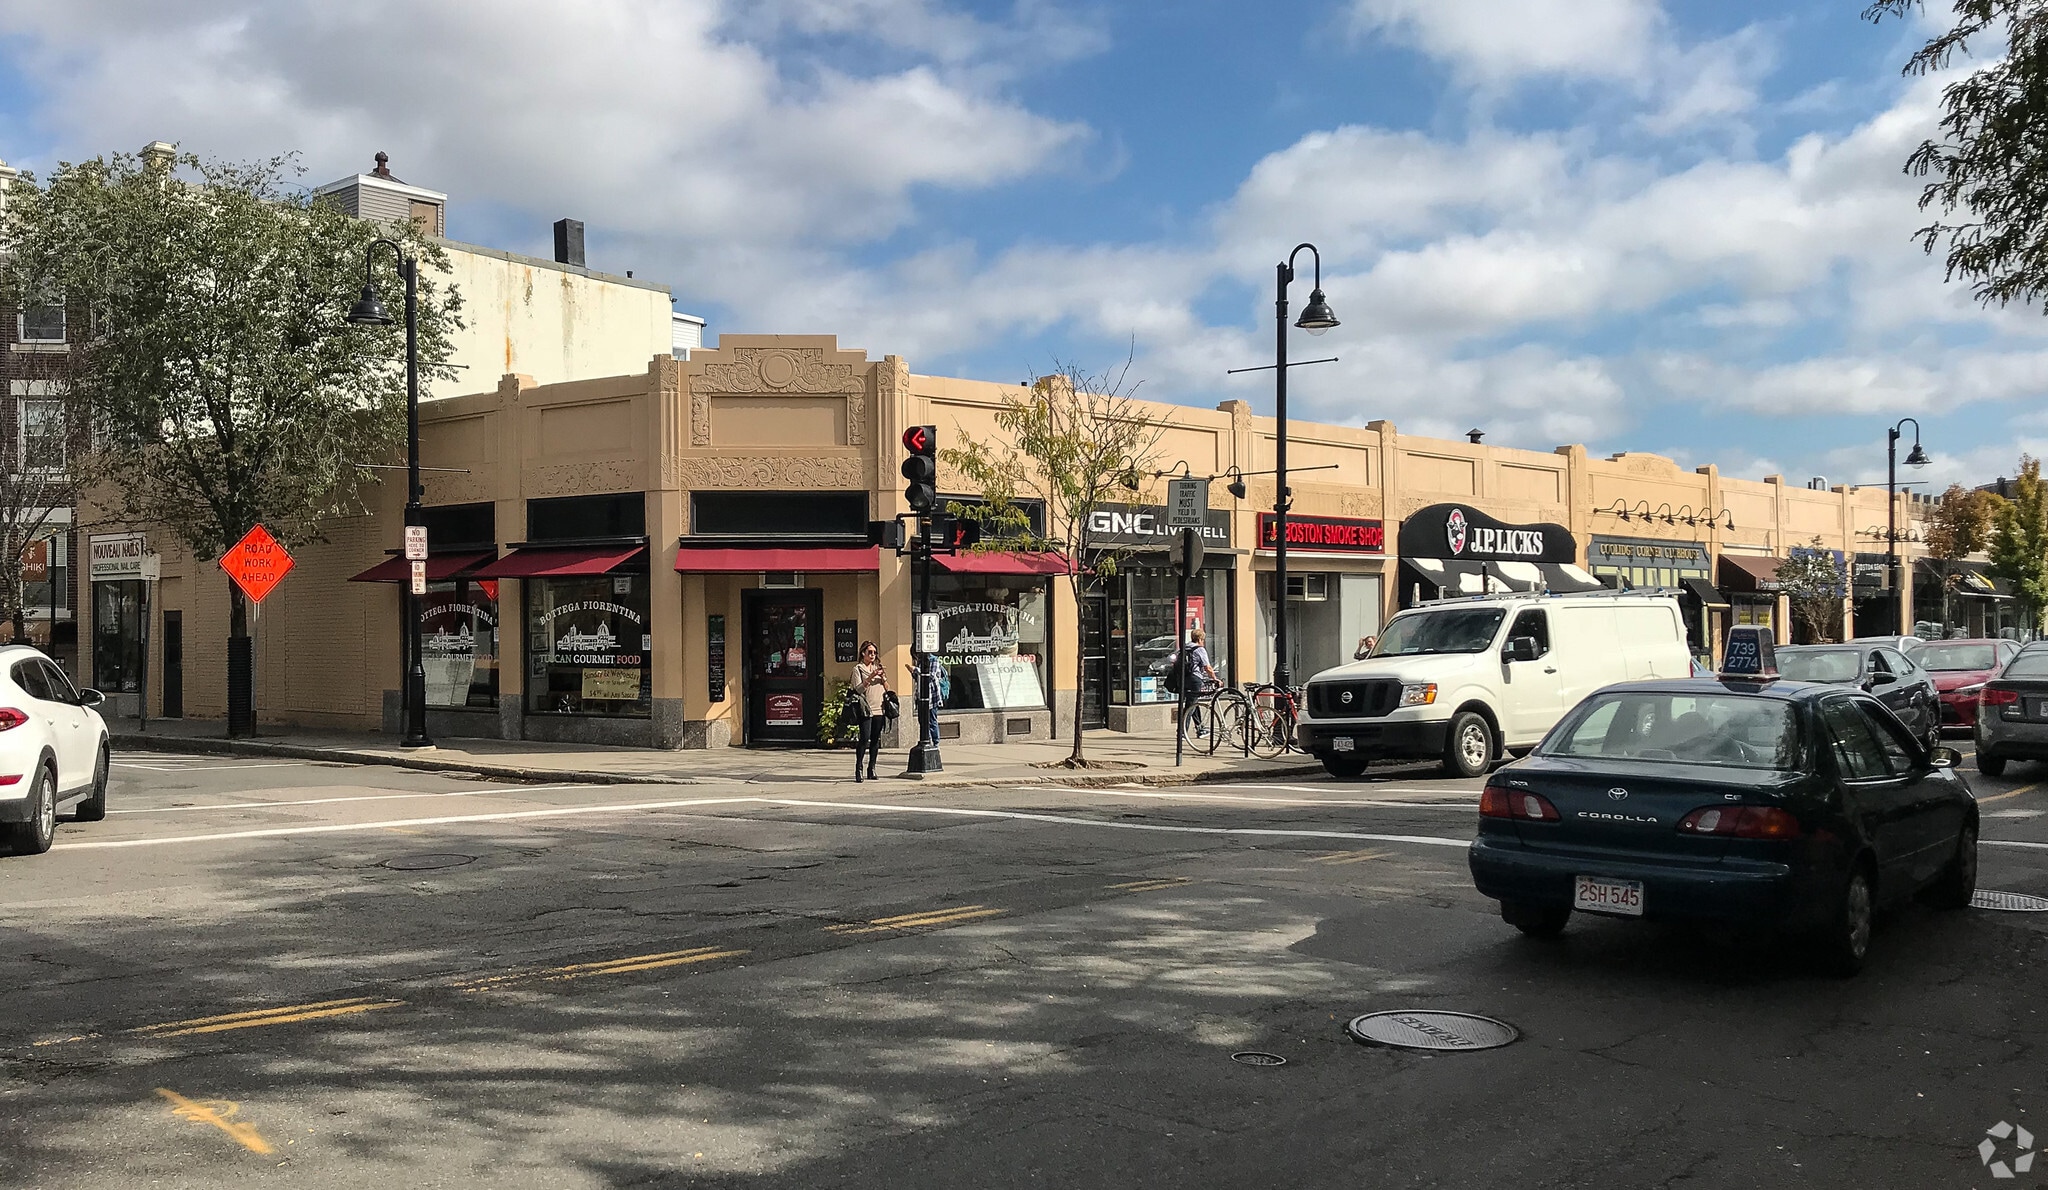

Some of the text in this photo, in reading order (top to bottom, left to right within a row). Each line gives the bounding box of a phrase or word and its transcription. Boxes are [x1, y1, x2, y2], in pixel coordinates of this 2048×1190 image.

[1179, 498, 1193, 507] MUST
[1089, 511, 1154, 535] GNC
[1285, 522, 1383, 546] BOSTON SMOKE SHOP
[94, 544, 120, 560] NOUVEAU
[245, 544, 272, 553] ROAD
[1636, 546, 1662, 558] CORNER
[92, 561, 141, 571] PROFESSIONAL NAIL CARE
[244, 559, 271, 568] WORK
[241, 573, 275, 582] AHEAD
[420, 605, 447, 623] OTTEGA
[540, 601, 641, 626] BOTTEGA FIORENTINA
[939, 604, 973, 620] TTEGA
[1732, 642, 1756, 655] 739
[441, 653, 474, 661] GOURMET
[573, 655, 615, 664] GOURMET
[616, 655, 641, 664] FOOD
[939, 655, 963, 664] SCAN
[1011, 654, 1036, 663] FOOD
[1728, 656, 1759, 668] 2774
[1578, 811, 1657, 822] COROLLA
[1580, 884, 1607, 903] 2SH
[1611, 887, 1639, 907] 545
